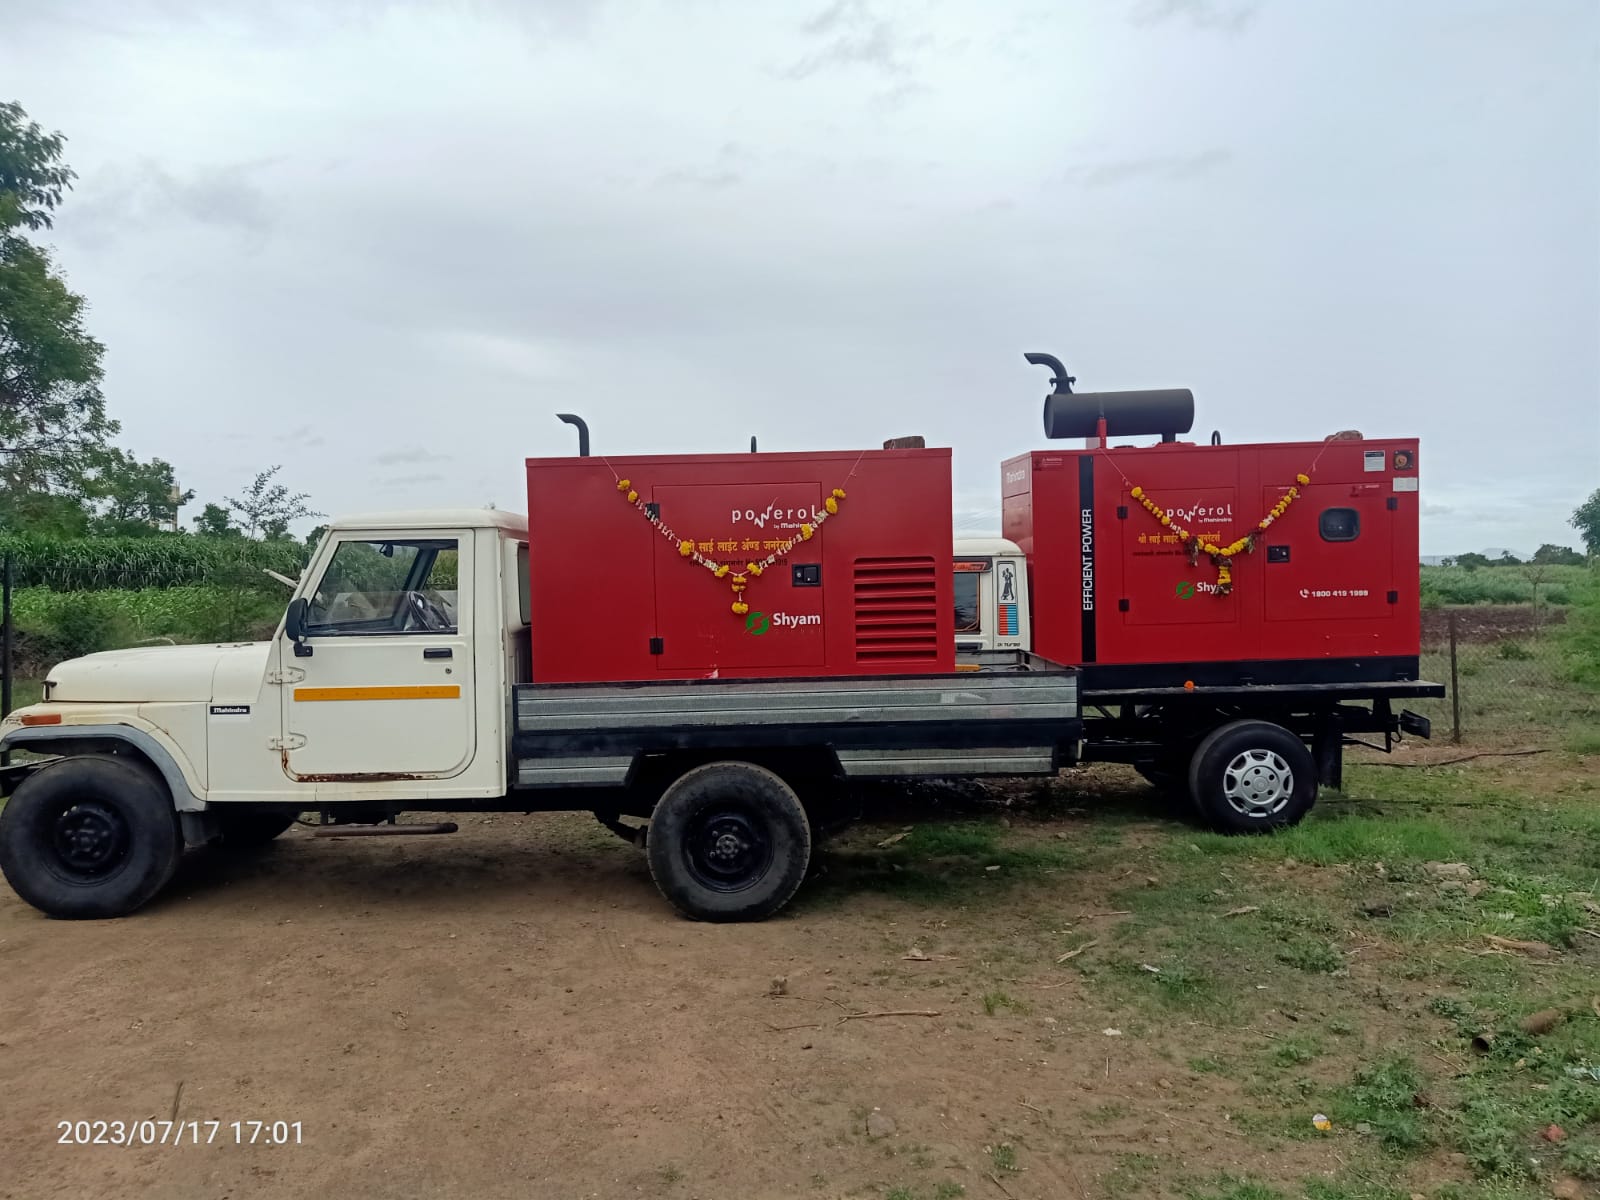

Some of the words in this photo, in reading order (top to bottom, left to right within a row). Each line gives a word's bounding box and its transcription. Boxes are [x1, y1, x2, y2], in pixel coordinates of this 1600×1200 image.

[1082, 508, 1093, 553] POWER
[1082, 555, 1094, 611] EFFICIENT
[1196, 581, 1232, 594] Shy
[772, 612, 821, 629] Shyam
